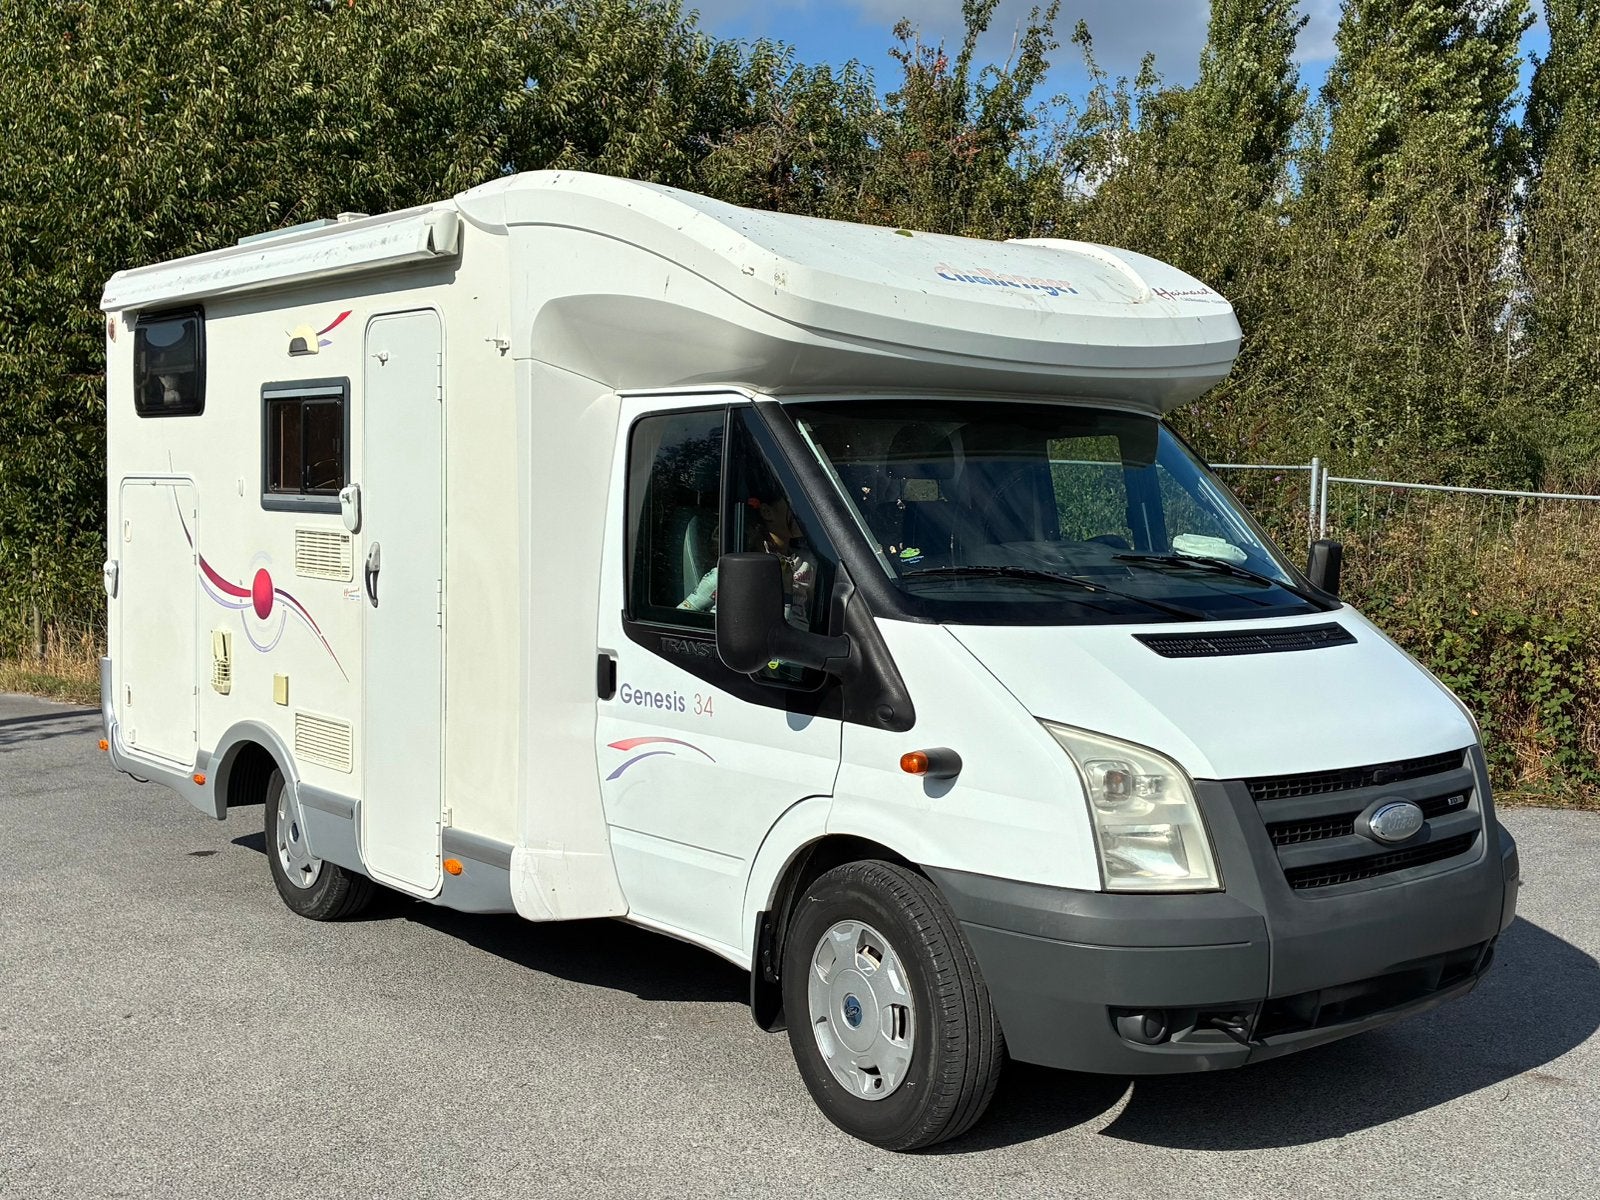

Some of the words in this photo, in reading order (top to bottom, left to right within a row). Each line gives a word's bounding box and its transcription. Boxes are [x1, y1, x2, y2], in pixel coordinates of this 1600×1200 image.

[660, 637, 718, 658] TRANSI
[620, 682, 686, 713] Genesis
[693, 692, 714, 718] 34
